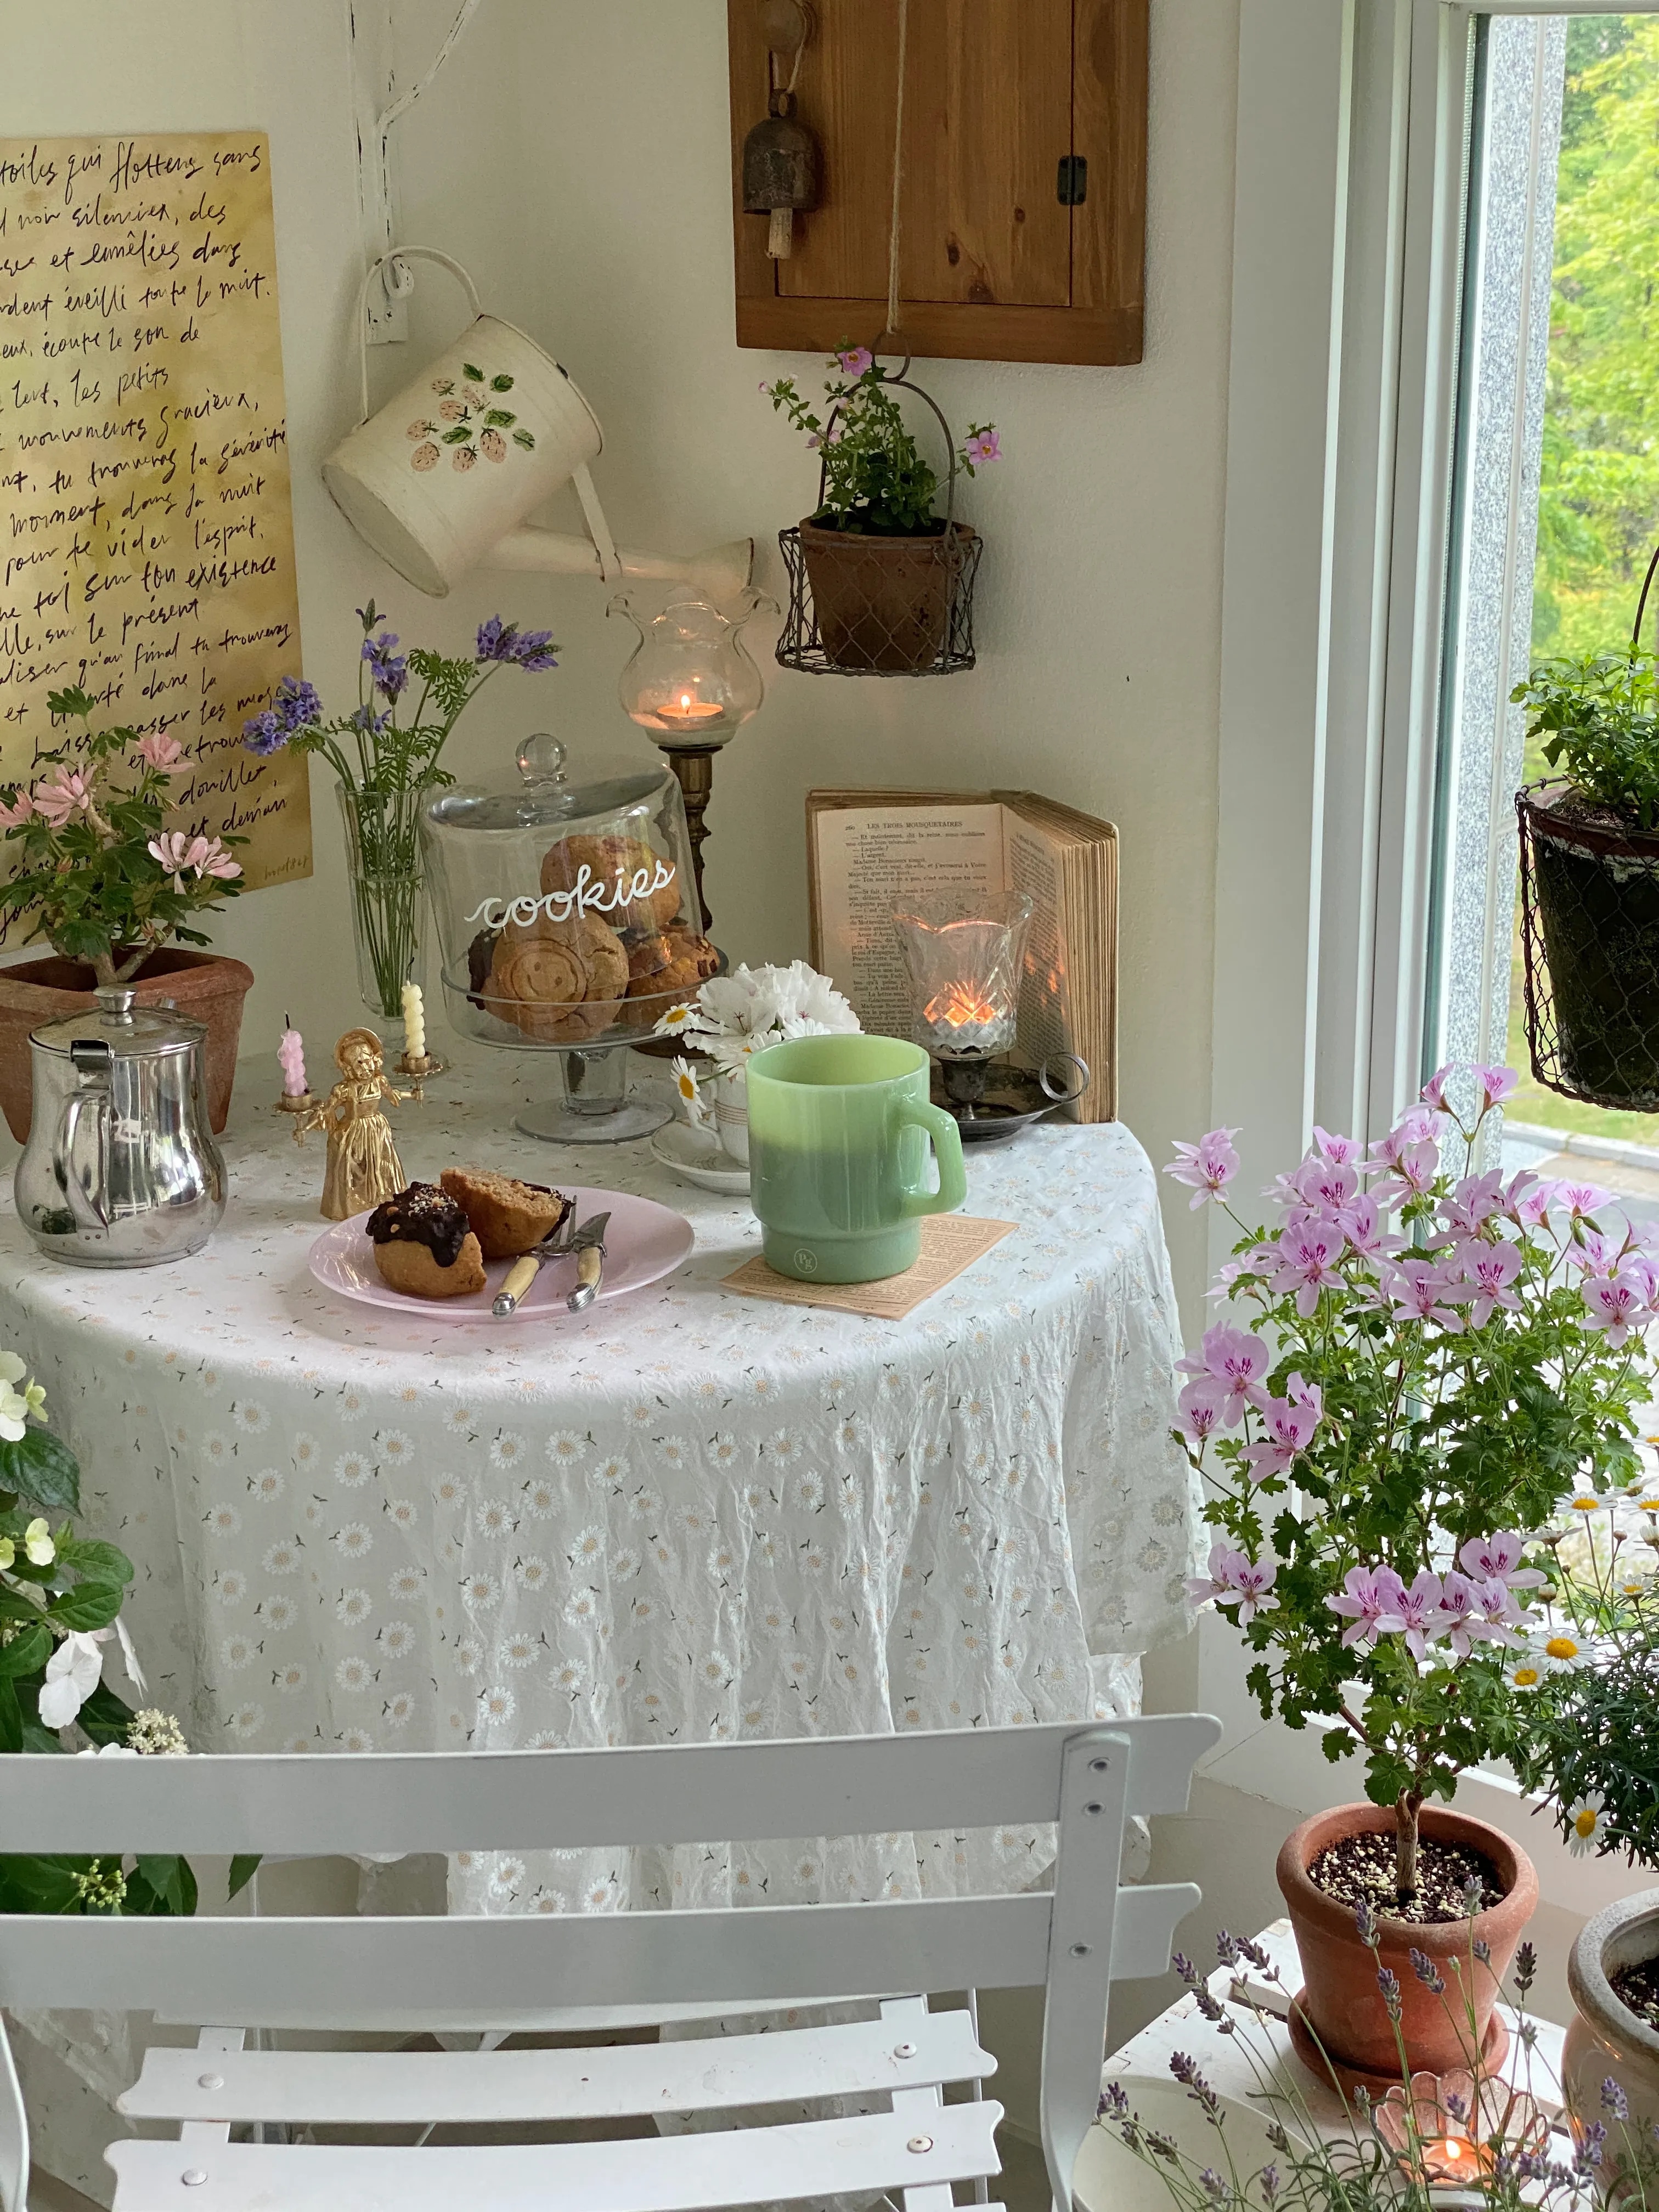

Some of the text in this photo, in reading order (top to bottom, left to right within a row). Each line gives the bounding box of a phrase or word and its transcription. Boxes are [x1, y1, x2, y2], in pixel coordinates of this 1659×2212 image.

[65, 145, 102, 205] qui
[190, 191, 225, 225] des
[49, 246, 75, 273] et
[133, 325, 169, 352] son
[180, 316, 200, 343] de
[70, 368, 101, 407] les
[48, 470, 74, 494] tu
[190, 442, 208, 475] la
[107, 524, 172, 557] vider
[140, 561, 176, 592] ton
[185, 555, 277, 591] existence
[87, 612, 107, 645] le
[121, 595, 199, 646] présent
[4, 702, 29, 725] et
[199, 699, 226, 726] les
[464, 859, 676, 929] cookies
